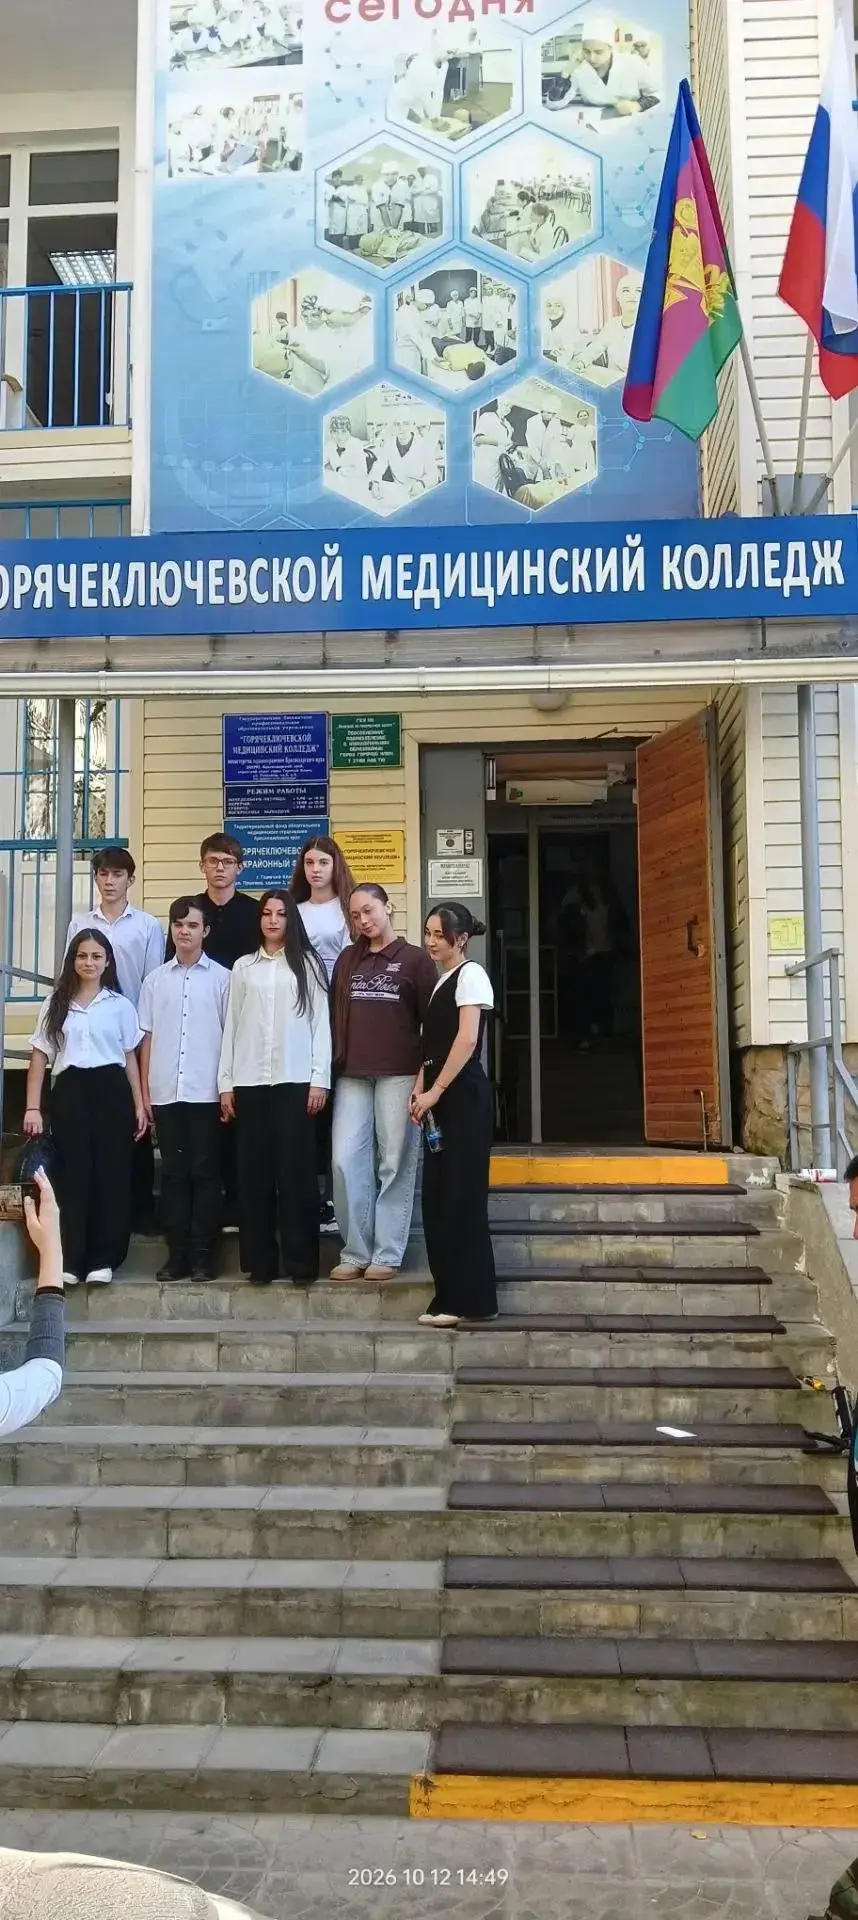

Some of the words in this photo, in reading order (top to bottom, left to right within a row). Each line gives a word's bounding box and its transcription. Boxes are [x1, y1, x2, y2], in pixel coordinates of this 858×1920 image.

[361, 533, 645, 610] МЕДИЦИНСКИЙ
[662, 539, 845, 599] КОЛЛЕДЖ
[242, 847, 303, 856] ОРЯЧЕКЛЮЧЕВС
